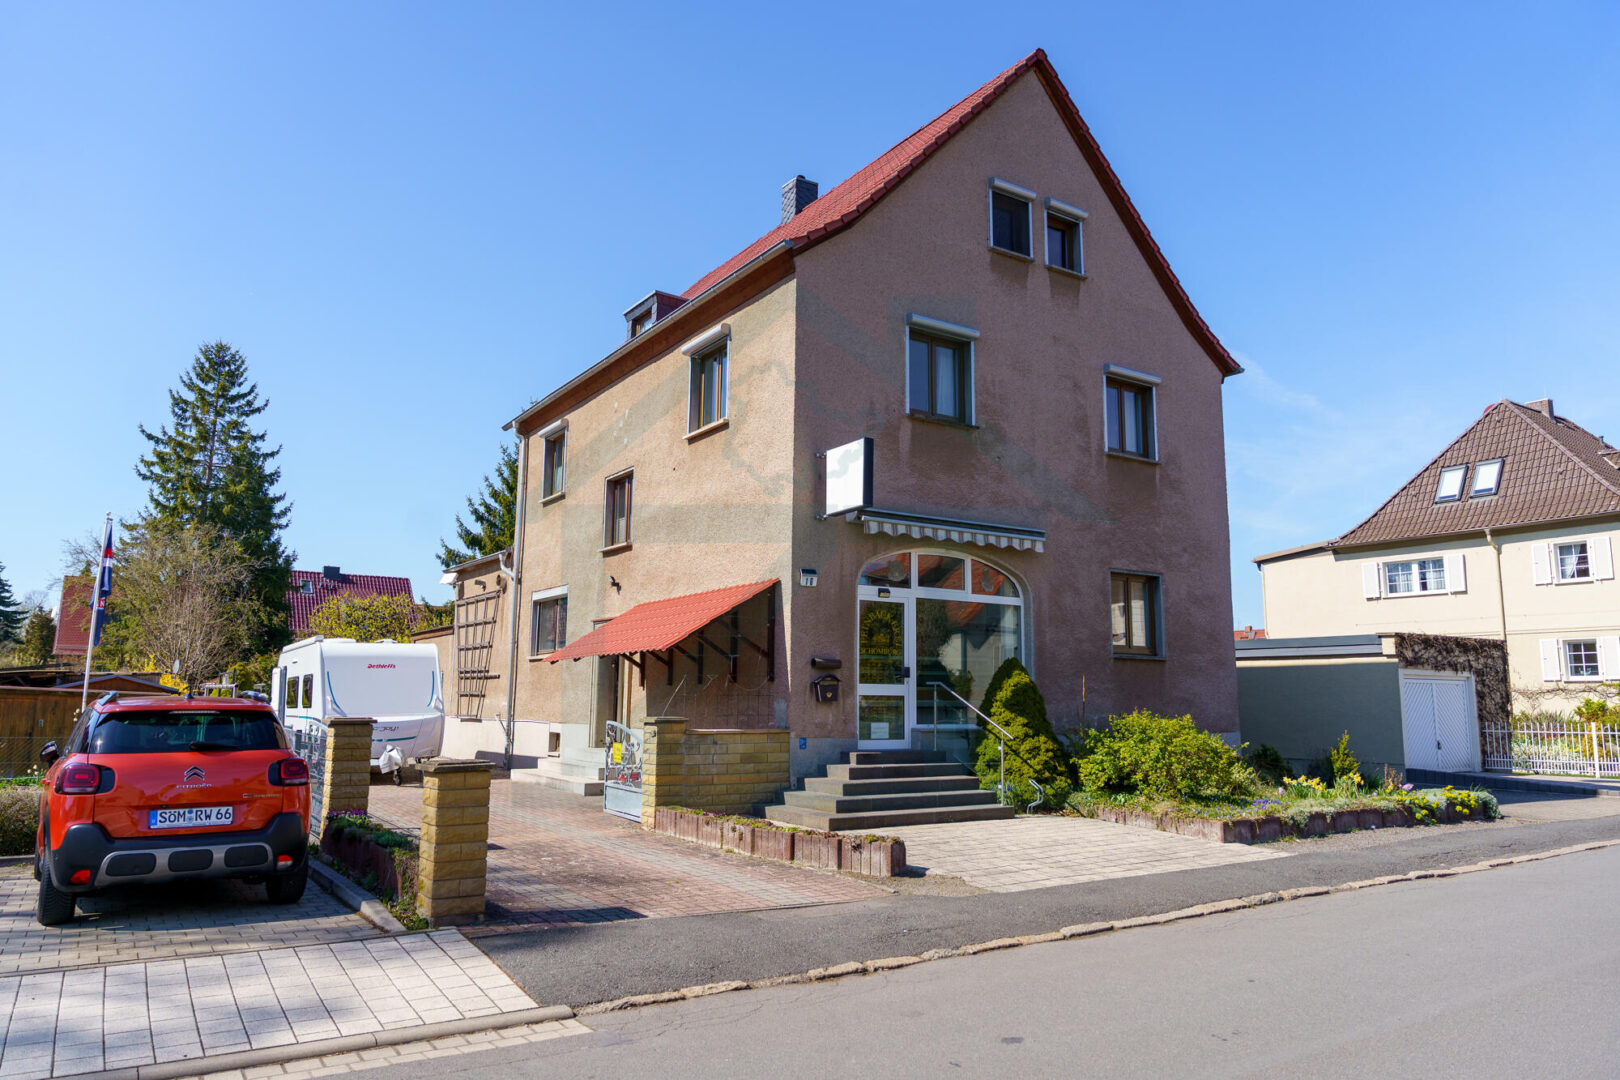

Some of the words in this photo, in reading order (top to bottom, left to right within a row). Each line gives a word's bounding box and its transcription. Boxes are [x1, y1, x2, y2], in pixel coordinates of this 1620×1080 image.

[158, 810, 187, 824] SÖM
[194, 809, 213, 821] RW
[215, 808, 232, 820] 66
